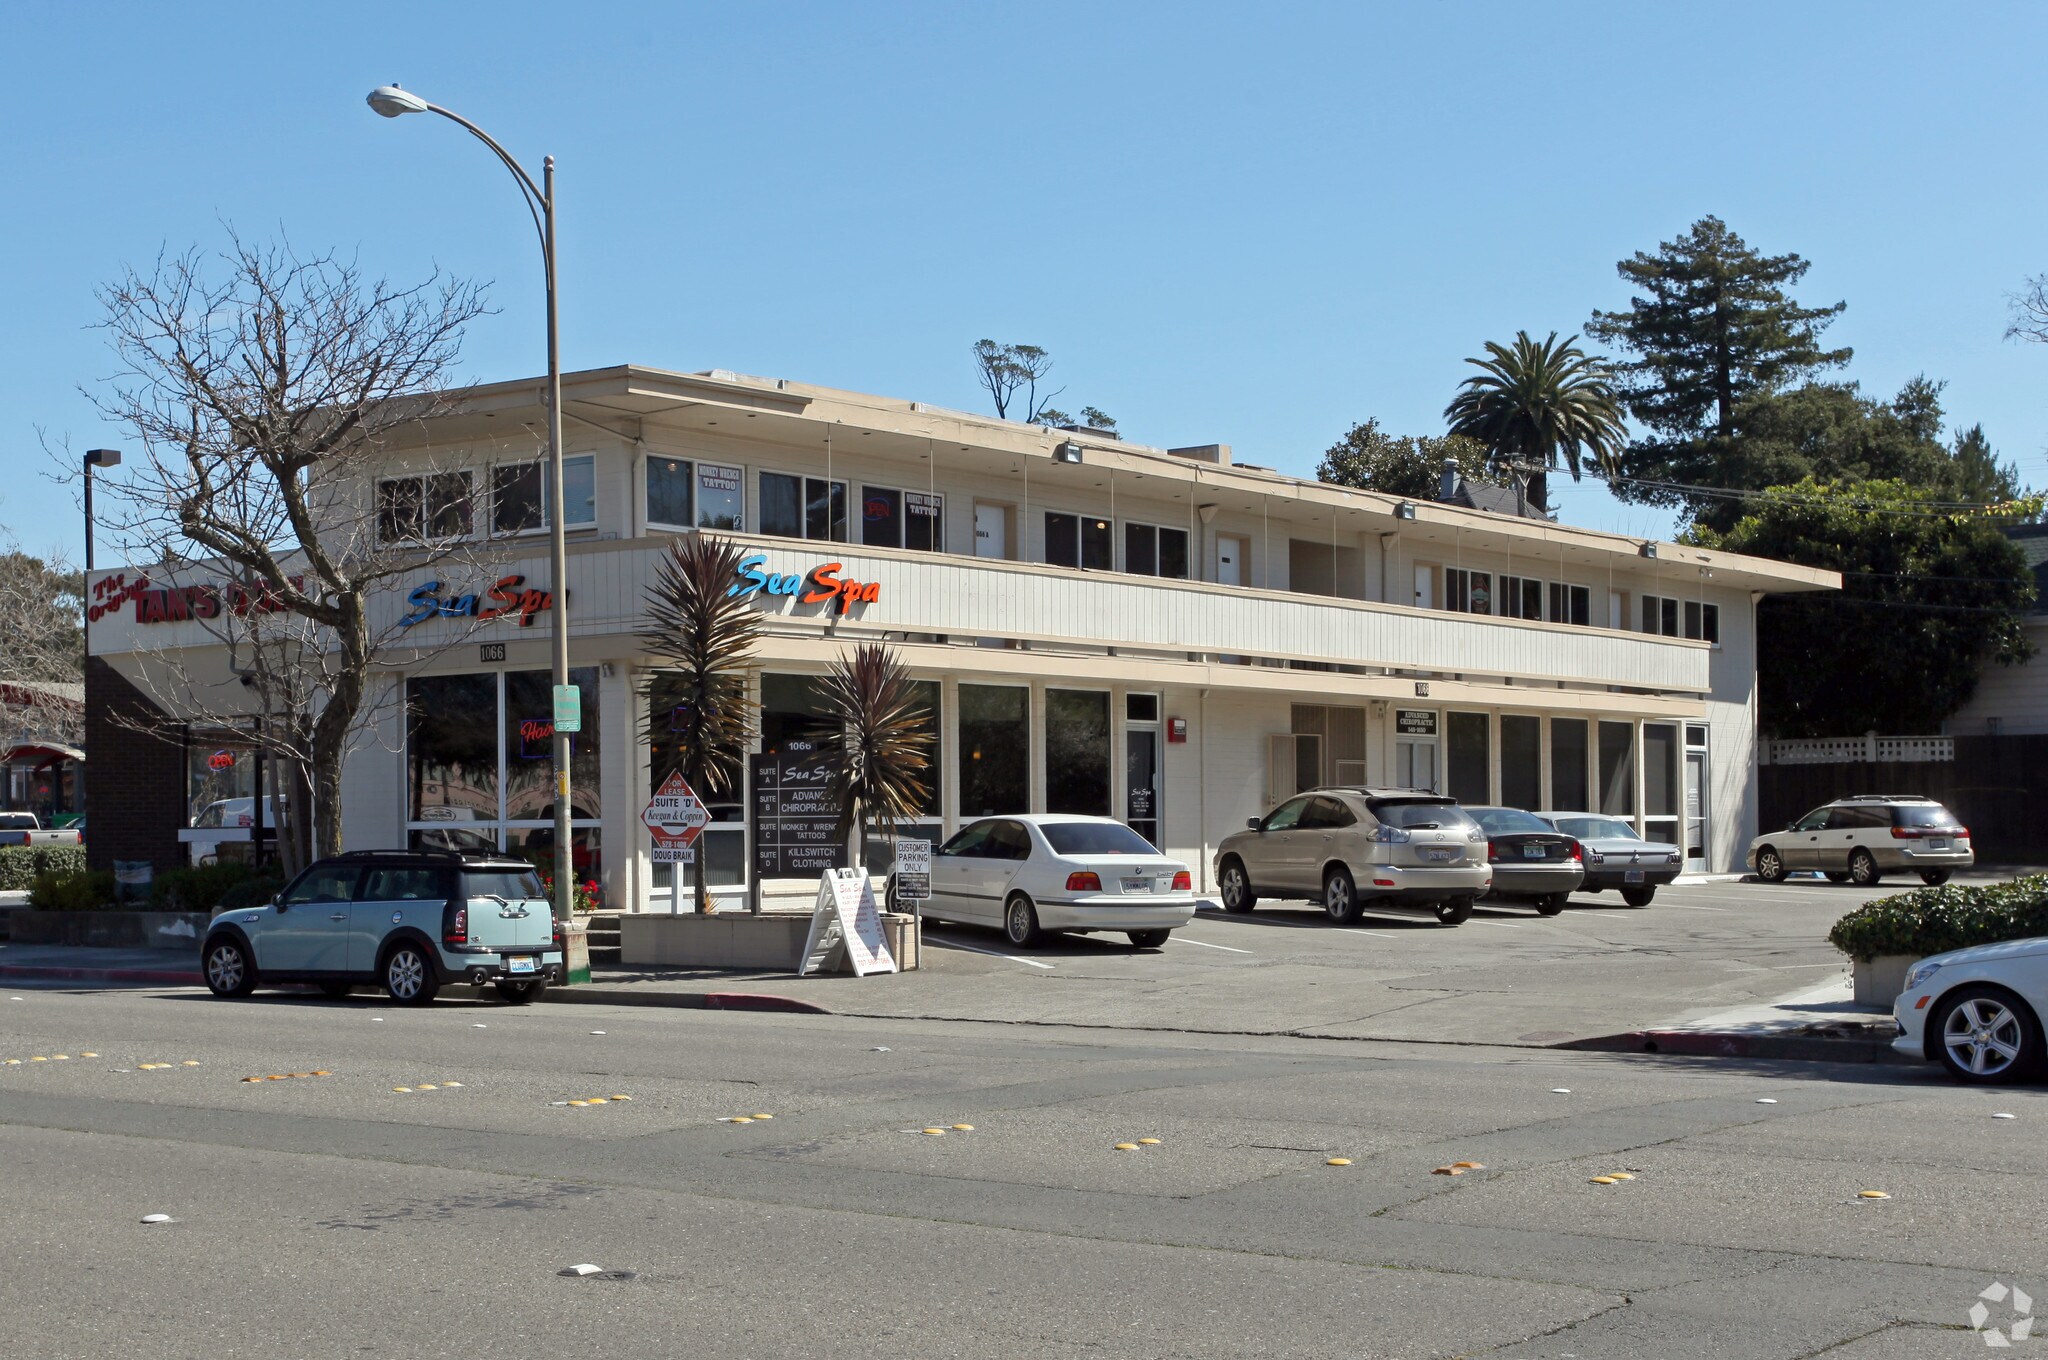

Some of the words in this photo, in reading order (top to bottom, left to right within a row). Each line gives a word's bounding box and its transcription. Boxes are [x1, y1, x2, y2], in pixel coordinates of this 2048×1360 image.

[703, 477, 736, 490] TATTOO
[93, 573, 125, 601] The
[728, 554, 802, 597] Sea
[803, 562, 881, 615] Spa
[88, 570, 150, 622] Original
[130, 583, 219, 624] TAN'S
[399, 580, 480, 627] Sea
[480, 646, 504, 661] 1066
[788, 741, 812, 751] 1066
[208, 753, 235, 768] OPEN
[759, 768, 777, 776] SUITE
[781, 766, 810, 783] Sea
[664, 788, 686, 796] LEASE
[655, 798, 679, 808] SUITE
[759, 795, 777, 803] SUITE
[648, 809, 671, 822] Keegan
[672, 809, 679, 821] &
[680, 809, 703, 823] Coppin
[759, 823, 777, 831] SUITE
[780, 823, 809, 831] MONKEY
[813, 823, 837, 831] WREN
[796, 831, 827, 840] TATTOOS
[787, 847, 836, 857] KILLSWITCH
[898, 843, 928, 853] CUSTOMER
[654, 850, 672, 861] DOUG
[673, 850, 692, 861] BRAIK
[759, 851, 777, 859] SUITE
[898, 853, 928, 862] PARKING
[792, 859, 832, 868] CLOTHING
[904, 863, 922, 872] ONLY
